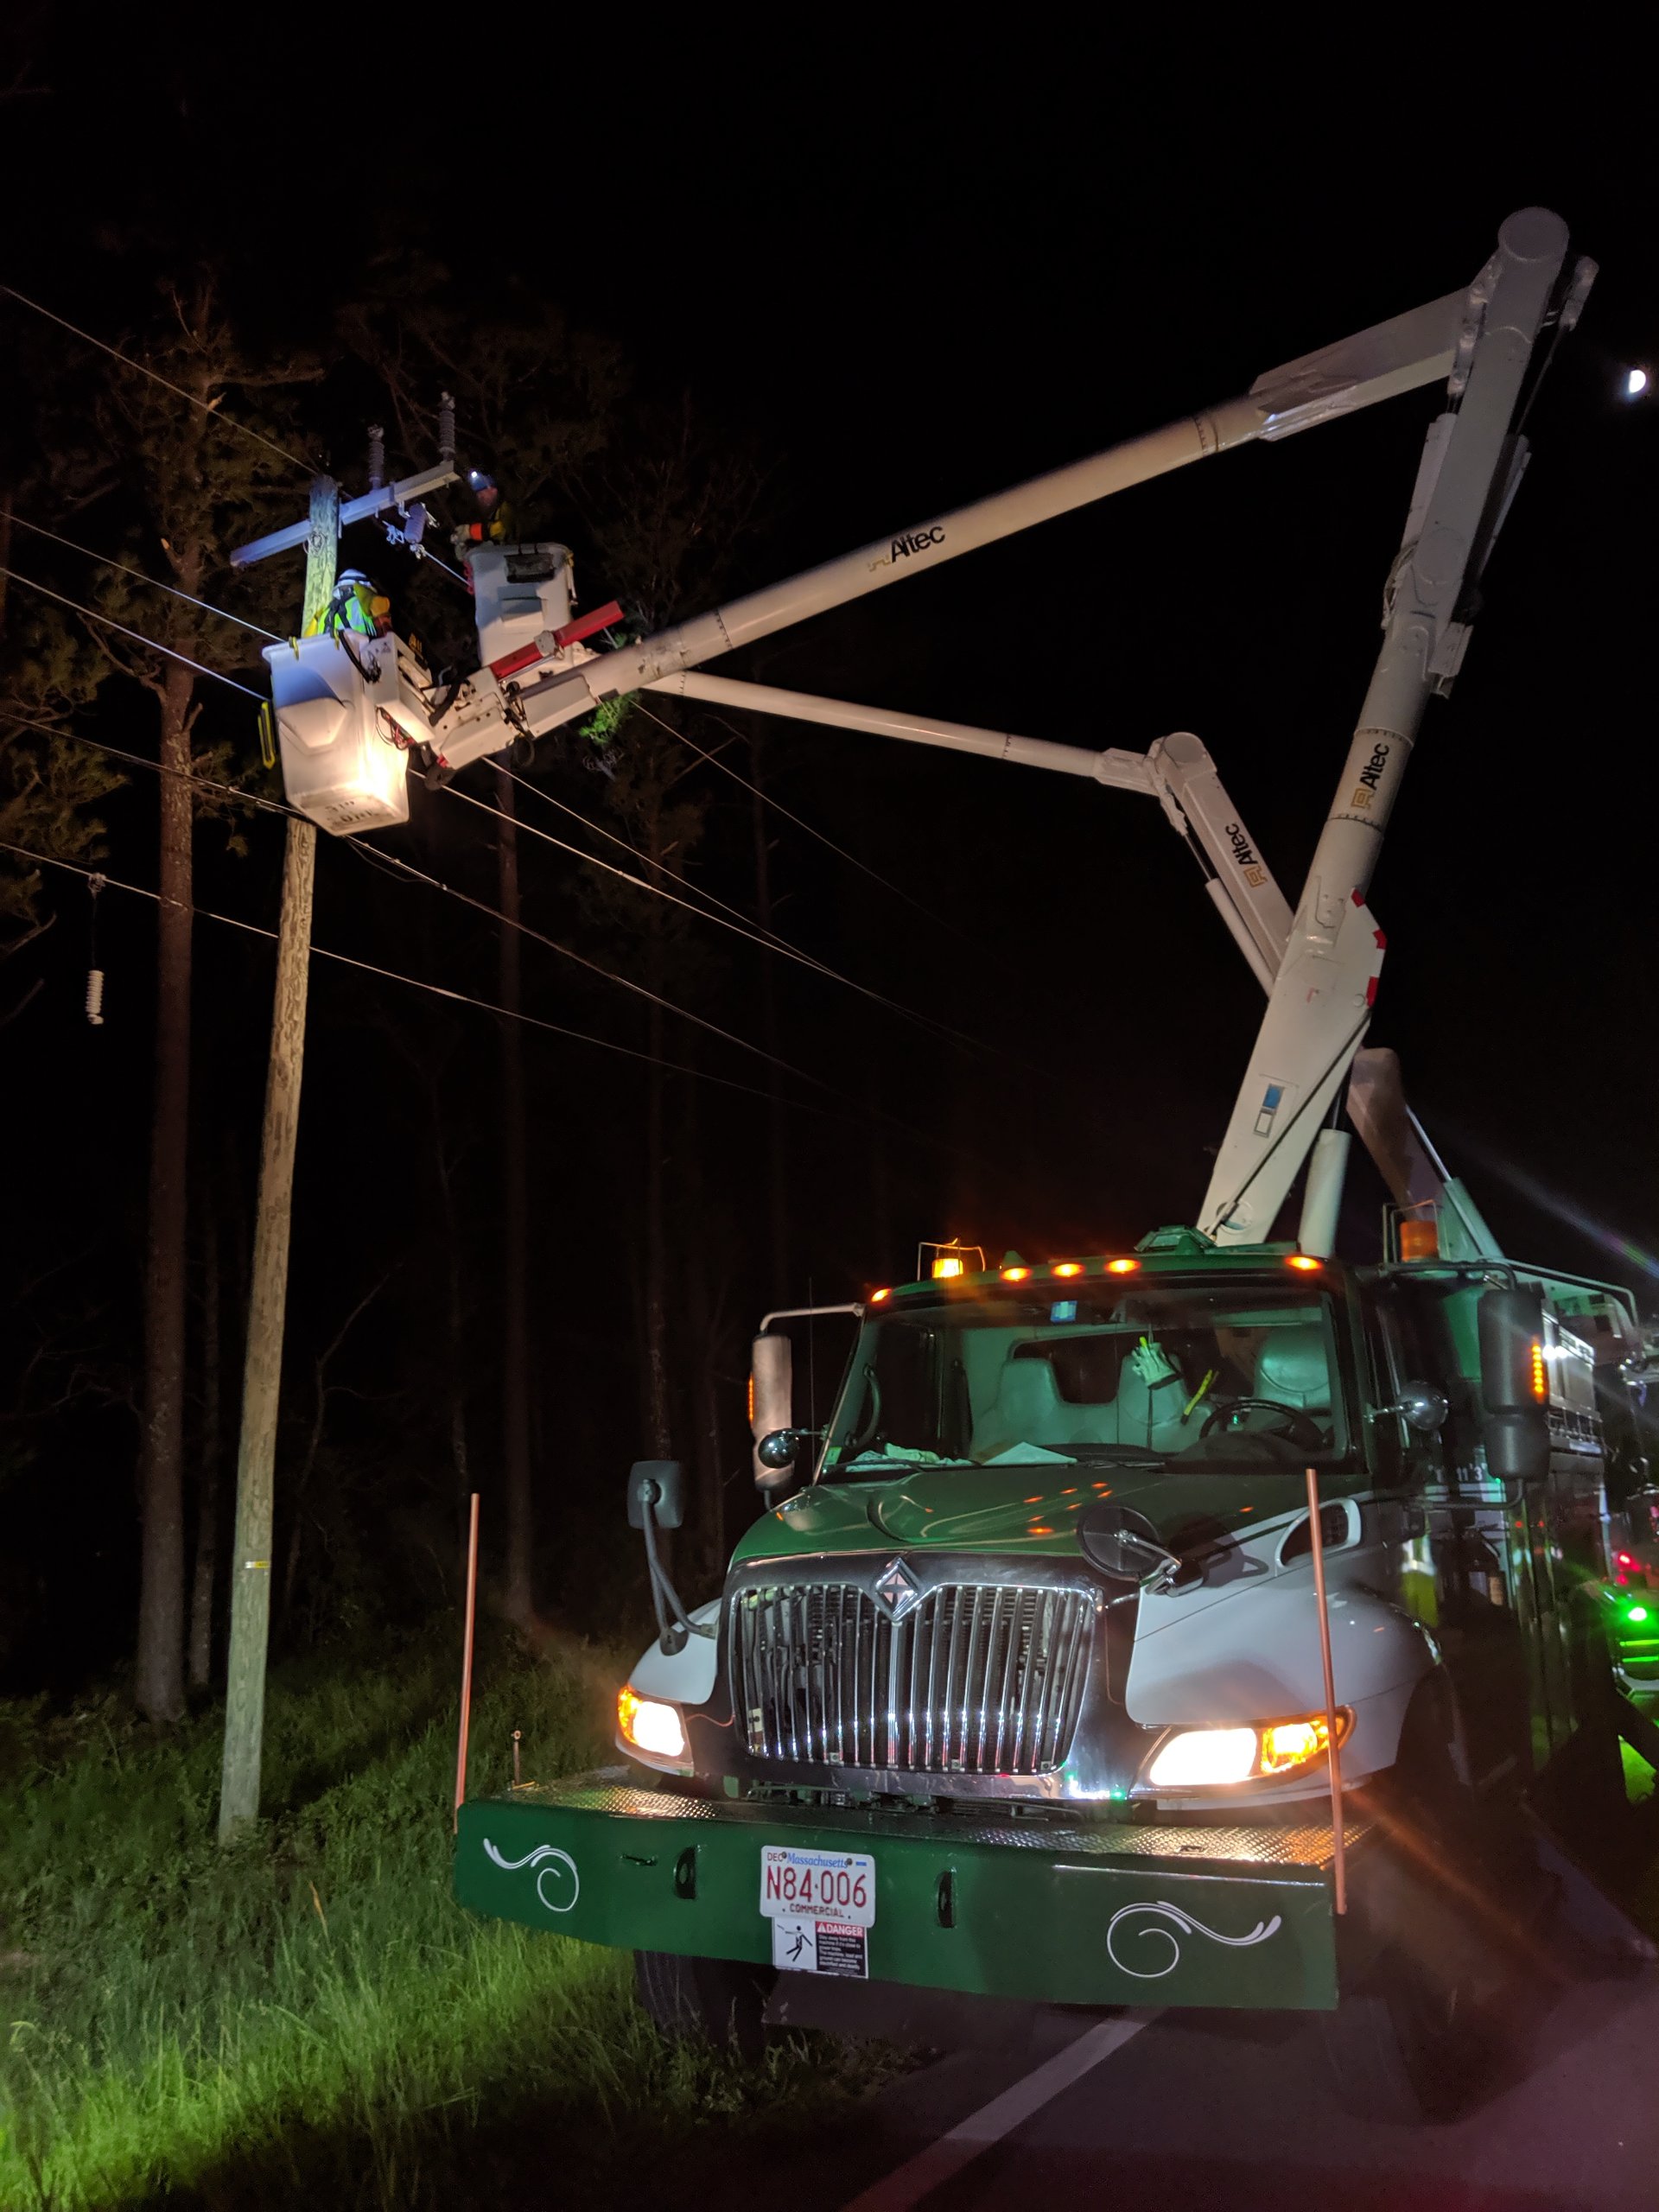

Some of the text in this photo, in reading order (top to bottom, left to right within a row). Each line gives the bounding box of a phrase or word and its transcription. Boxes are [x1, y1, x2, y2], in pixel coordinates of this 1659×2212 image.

[892, 525, 946, 563] Altec
[1359, 743, 1389, 791] Altec
[1225, 823, 1258, 866] Altec
[767, 1852, 849, 1869] DEC Massachusetts
[789, 1903, 845, 1917] COMMERCIAL
[826, 1923, 863, 1936] DANGER
